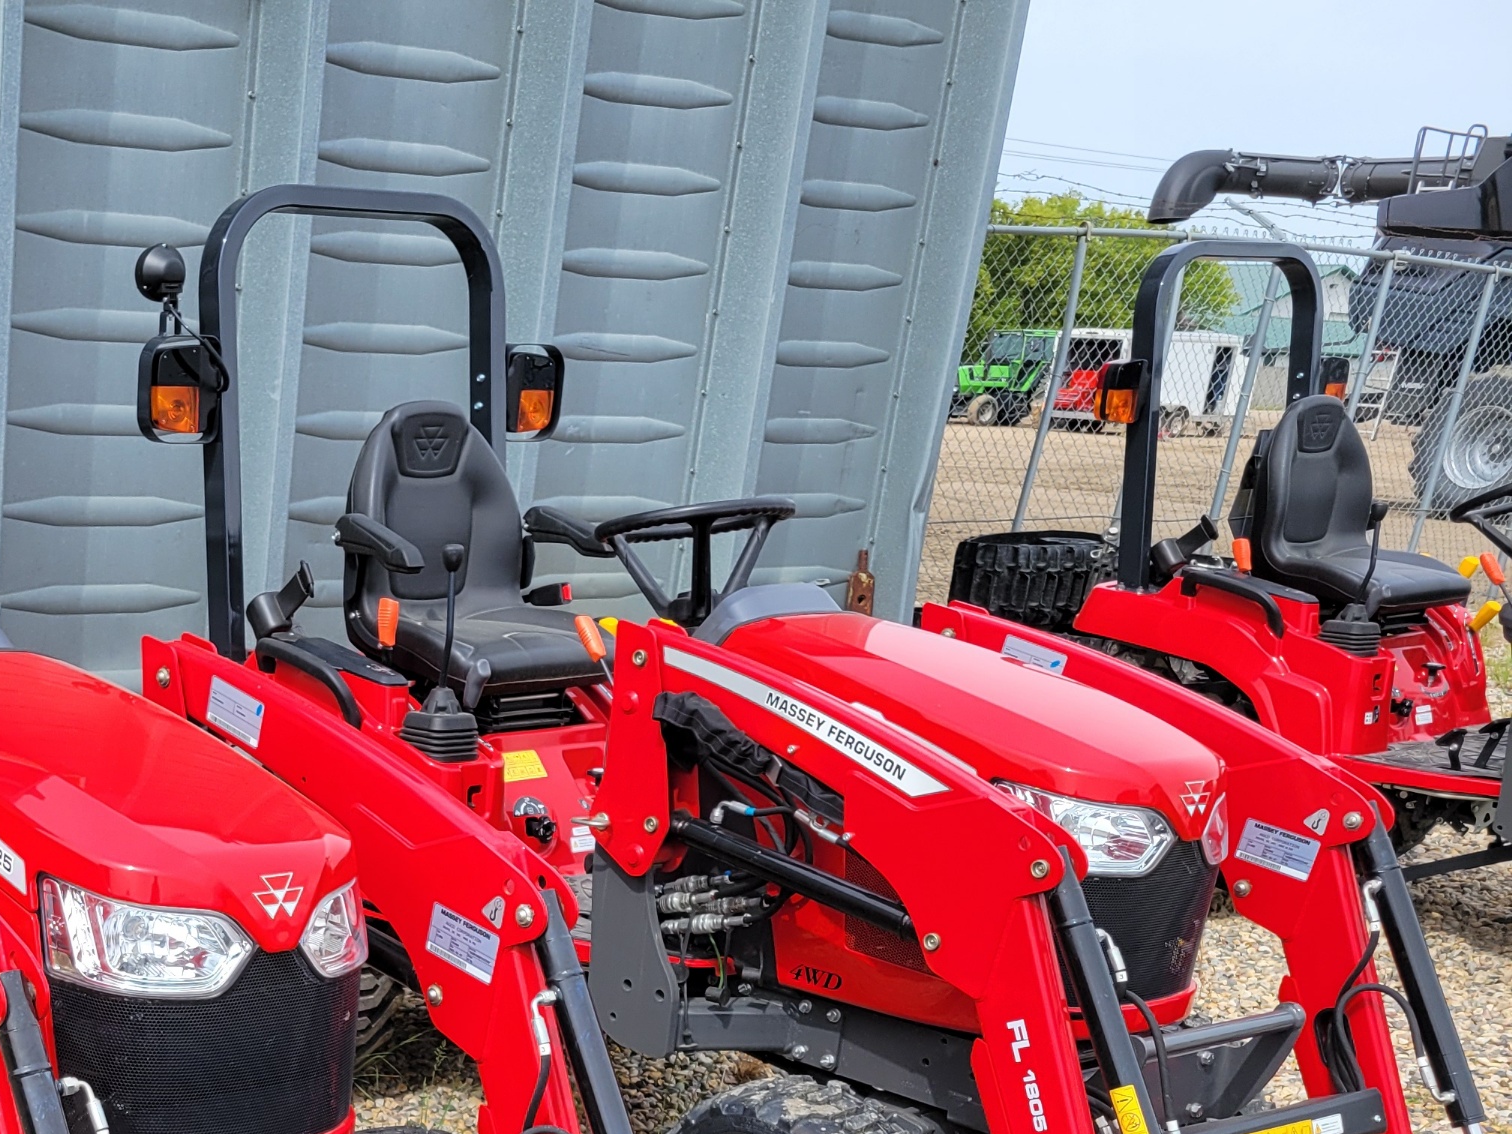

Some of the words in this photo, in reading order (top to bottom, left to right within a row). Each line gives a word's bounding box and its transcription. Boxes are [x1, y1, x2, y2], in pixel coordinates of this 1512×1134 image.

[766, 692, 826, 731] MASSEY
[827, 725, 907, 781] FERGUSON
[1254, 822, 1279, 835] MASSEY
[1278, 831, 1311, 846] FERGUSON
[440, 908, 463, 924] MASSEY
[462, 920, 491, 941] FERGUSON
[789, 963, 843, 990] 4WD
[1006, 1018, 1031, 1063] FL
[1022, 1069, 1048, 1132] 1805
